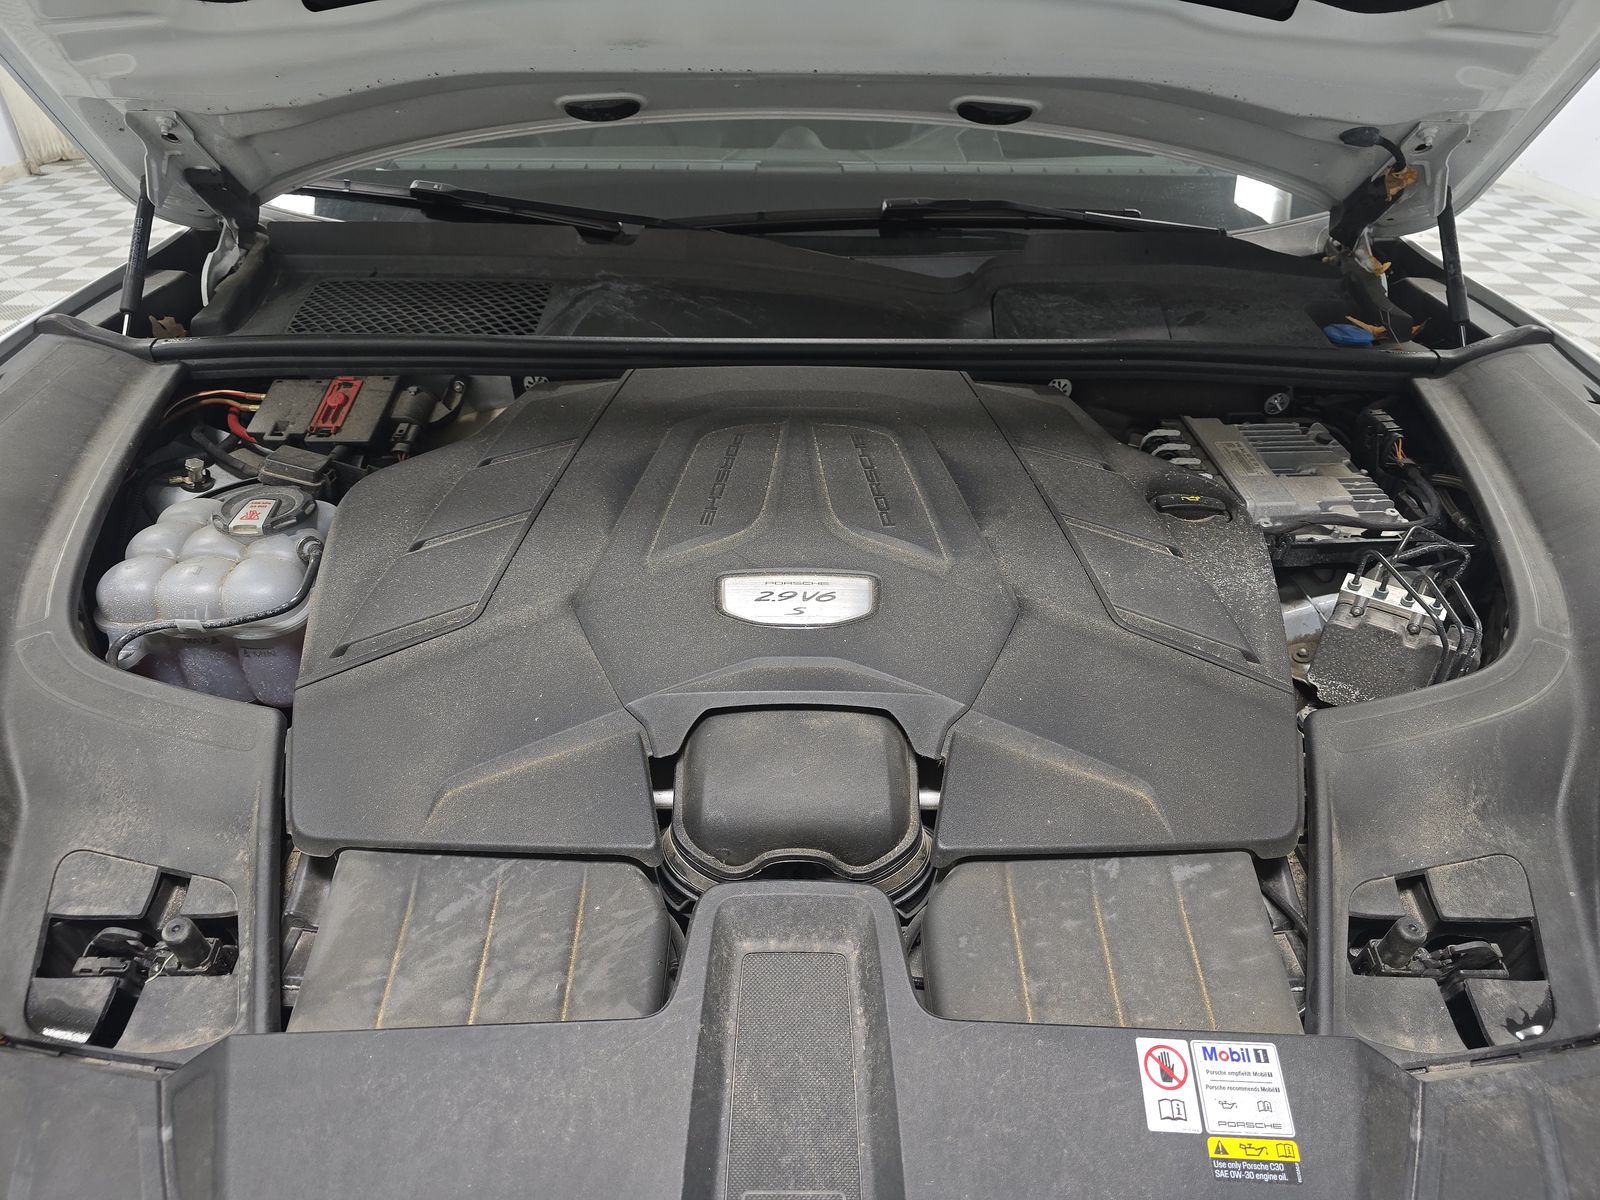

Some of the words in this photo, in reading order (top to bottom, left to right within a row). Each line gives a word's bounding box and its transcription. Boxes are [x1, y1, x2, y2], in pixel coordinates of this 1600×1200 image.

[700, 433, 745, 526] PORSCHE
[850, 434, 896, 527] PORSCHE
[784, 607, 807, 616] S
[1202, 1046, 1251, 1063] Mobil
[1218, 1121, 1282, 1129] PORSCHE
[1213, 1160, 1227, 1169] Use
[1227, 1161, 1242, 1170] only
[1242, 1161, 1269, 1170] Porsche
[1269, 1162, 1284, 1171] C30
[1214, 1170, 1229, 1178] SAE
[1229, 1170, 1254, 1179] 0W-30
[1255, 1172, 1277, 1182] engine
[1278, 1173, 1288, 1181] oil.
